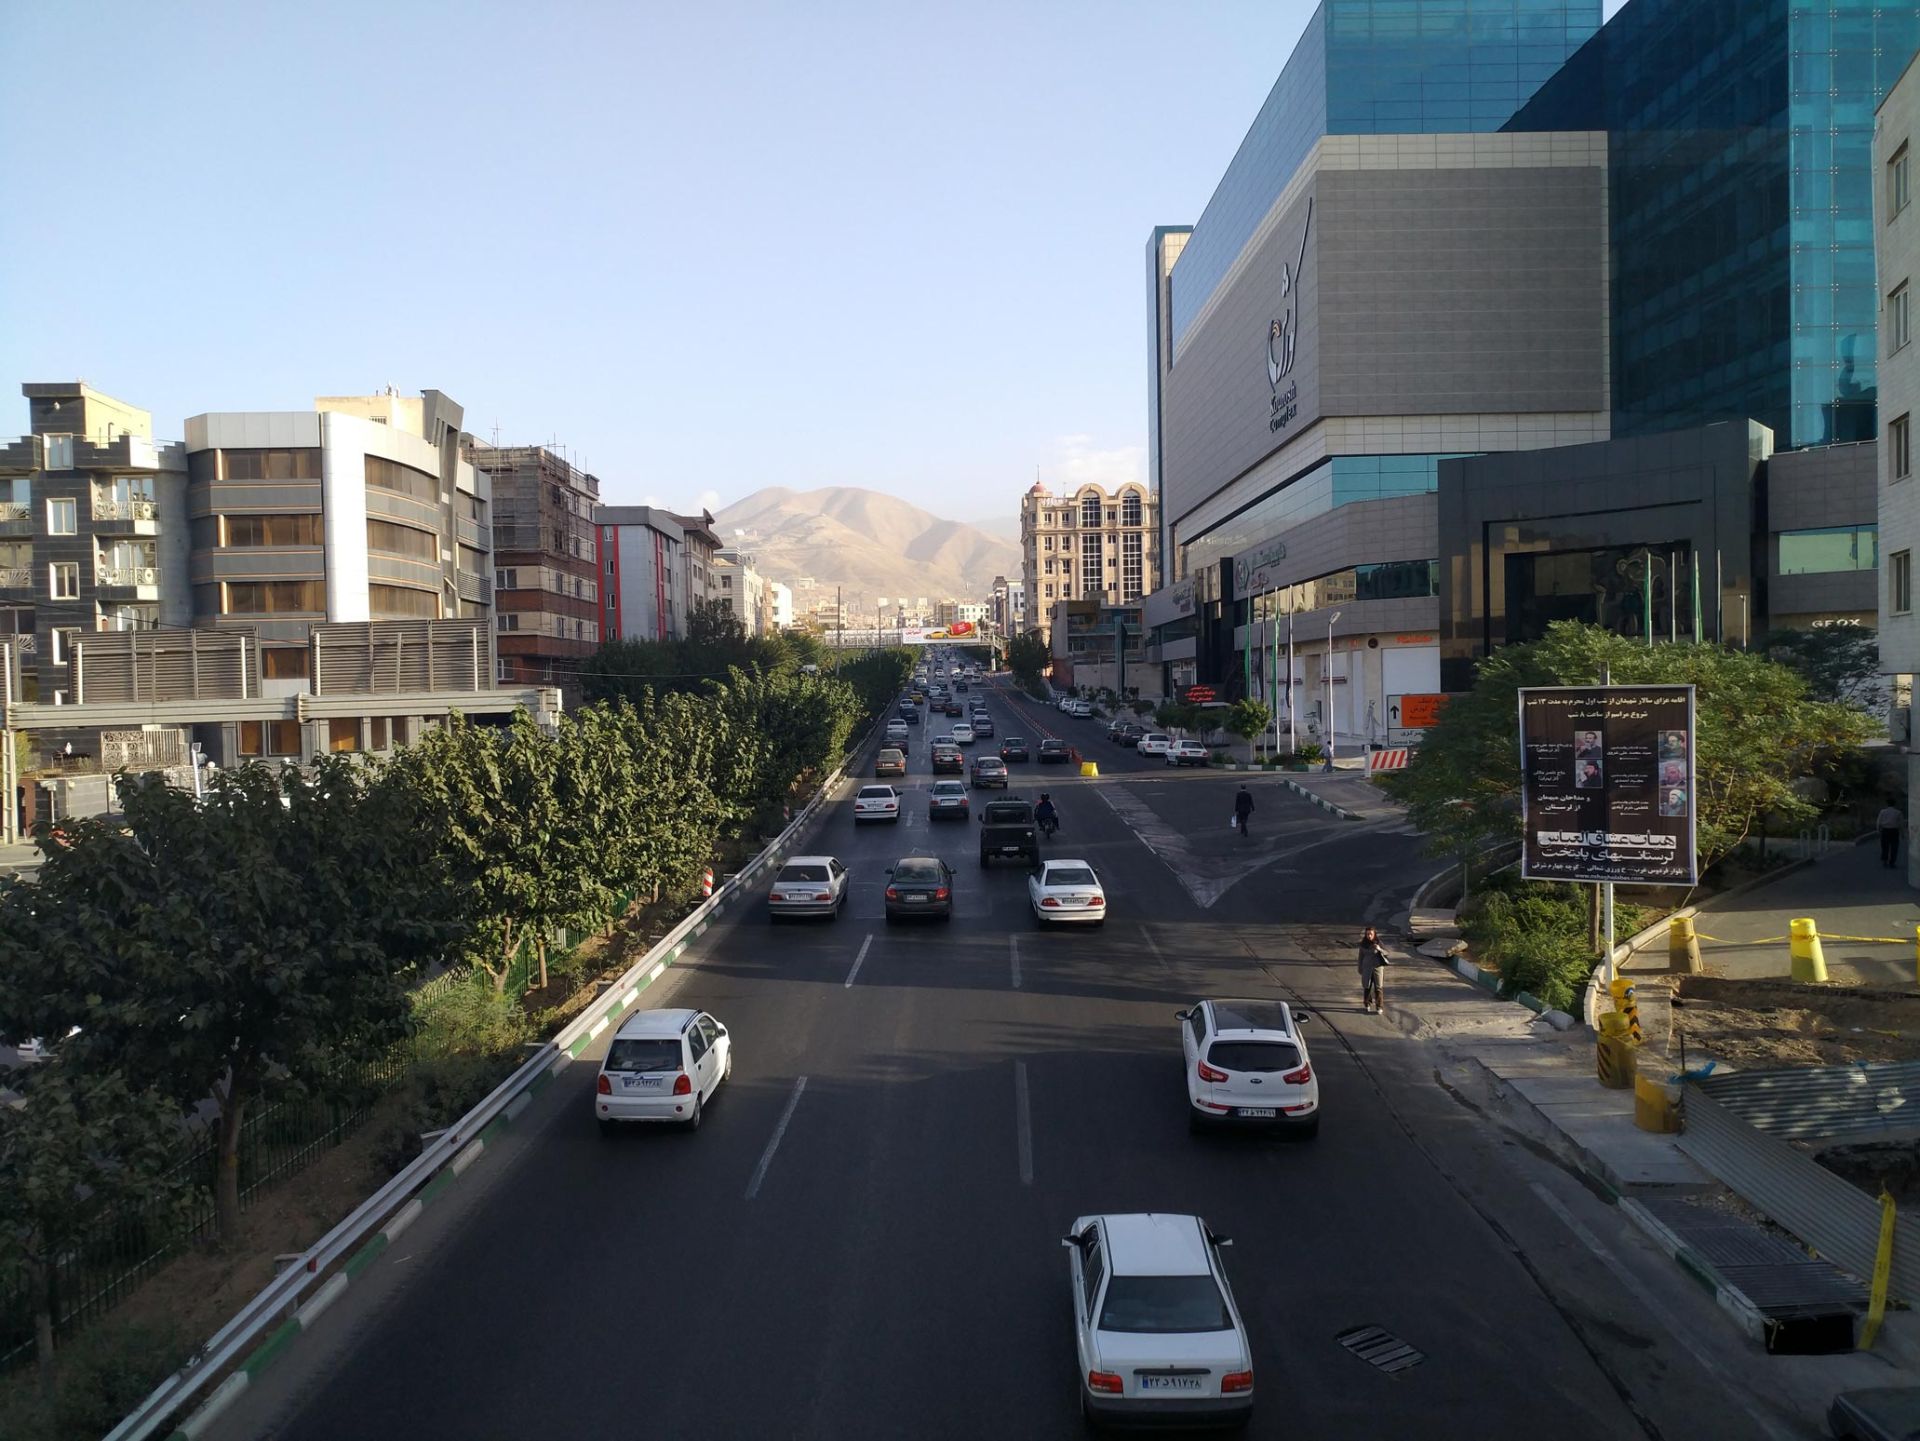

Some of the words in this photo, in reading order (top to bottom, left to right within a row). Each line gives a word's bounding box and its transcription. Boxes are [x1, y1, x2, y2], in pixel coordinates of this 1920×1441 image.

[1585, 697, 1596, 706] اول
[1615, 697, 1637, 705] شهیدان
[1630, 710, 1648, 719] شروع
[1541, 846, 1589, 861] پایتخت
